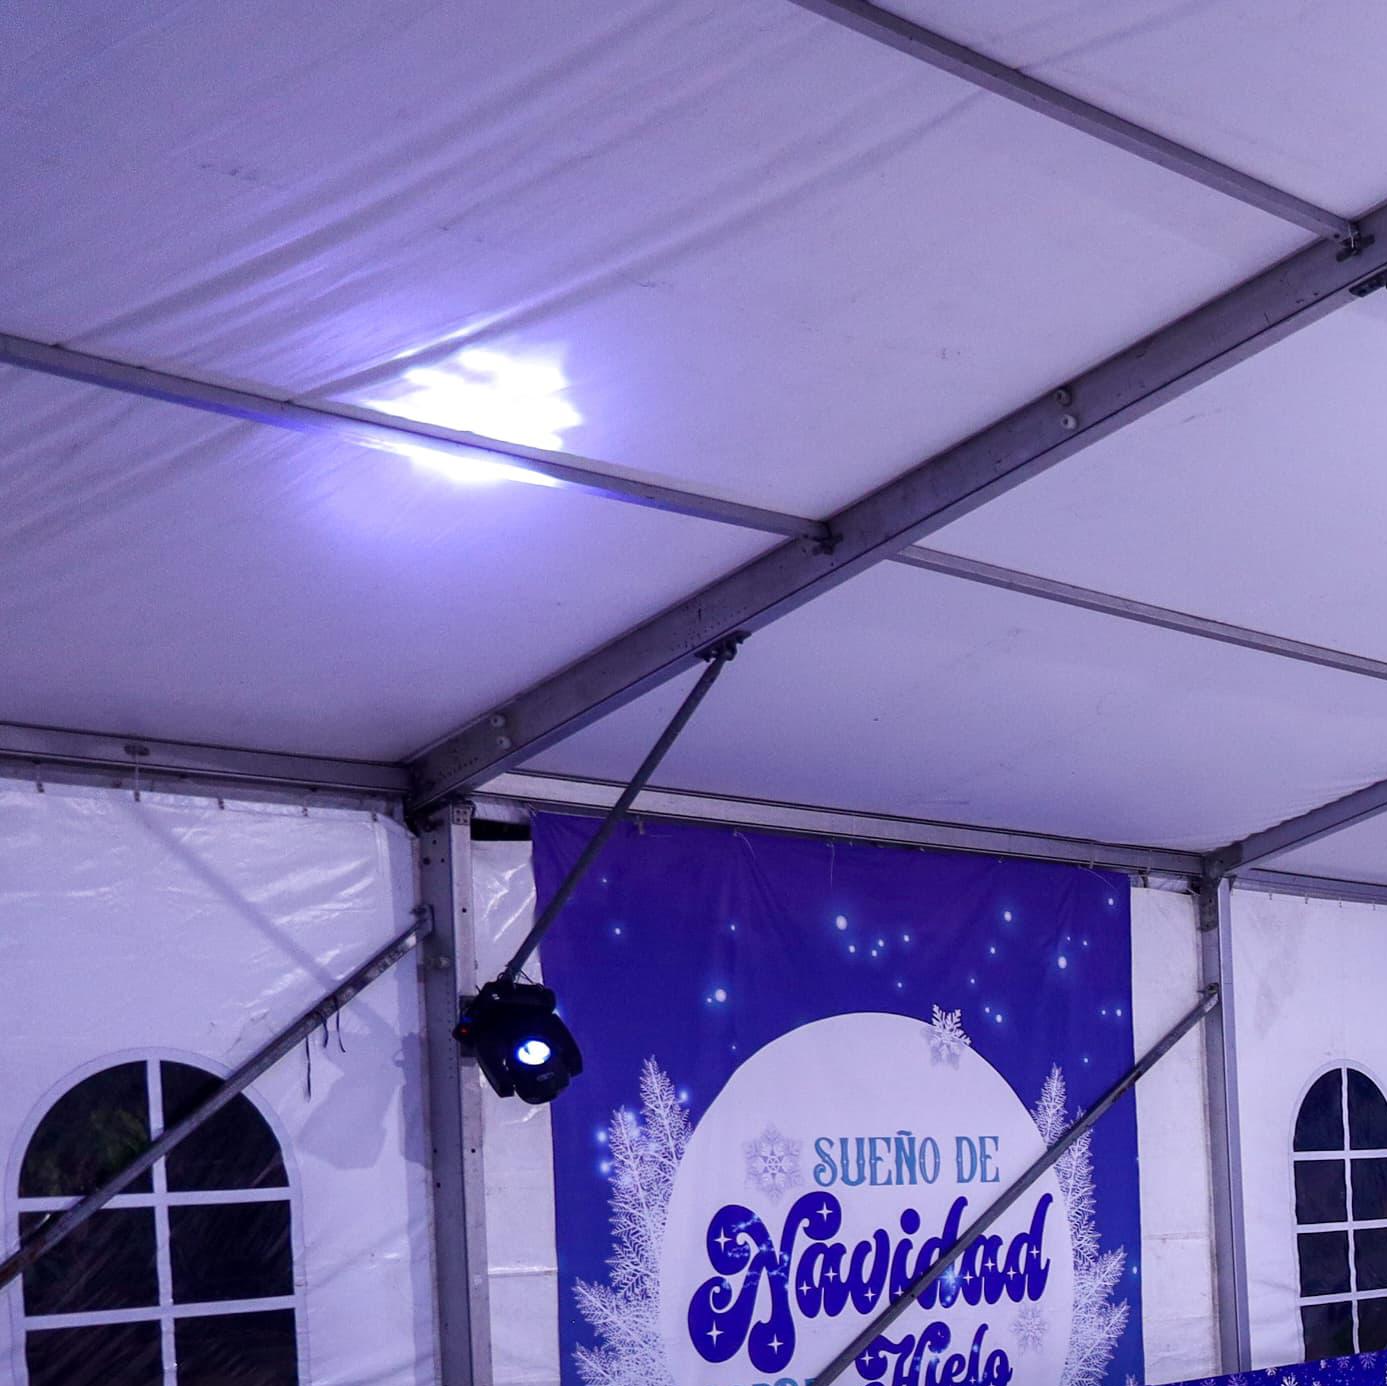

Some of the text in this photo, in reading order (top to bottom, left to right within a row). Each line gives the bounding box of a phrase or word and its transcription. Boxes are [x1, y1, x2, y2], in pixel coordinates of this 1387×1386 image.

[813, 1129, 1001, 1188] SUEÑO DE
[688, 1190, 1053, 1374] Navidad
